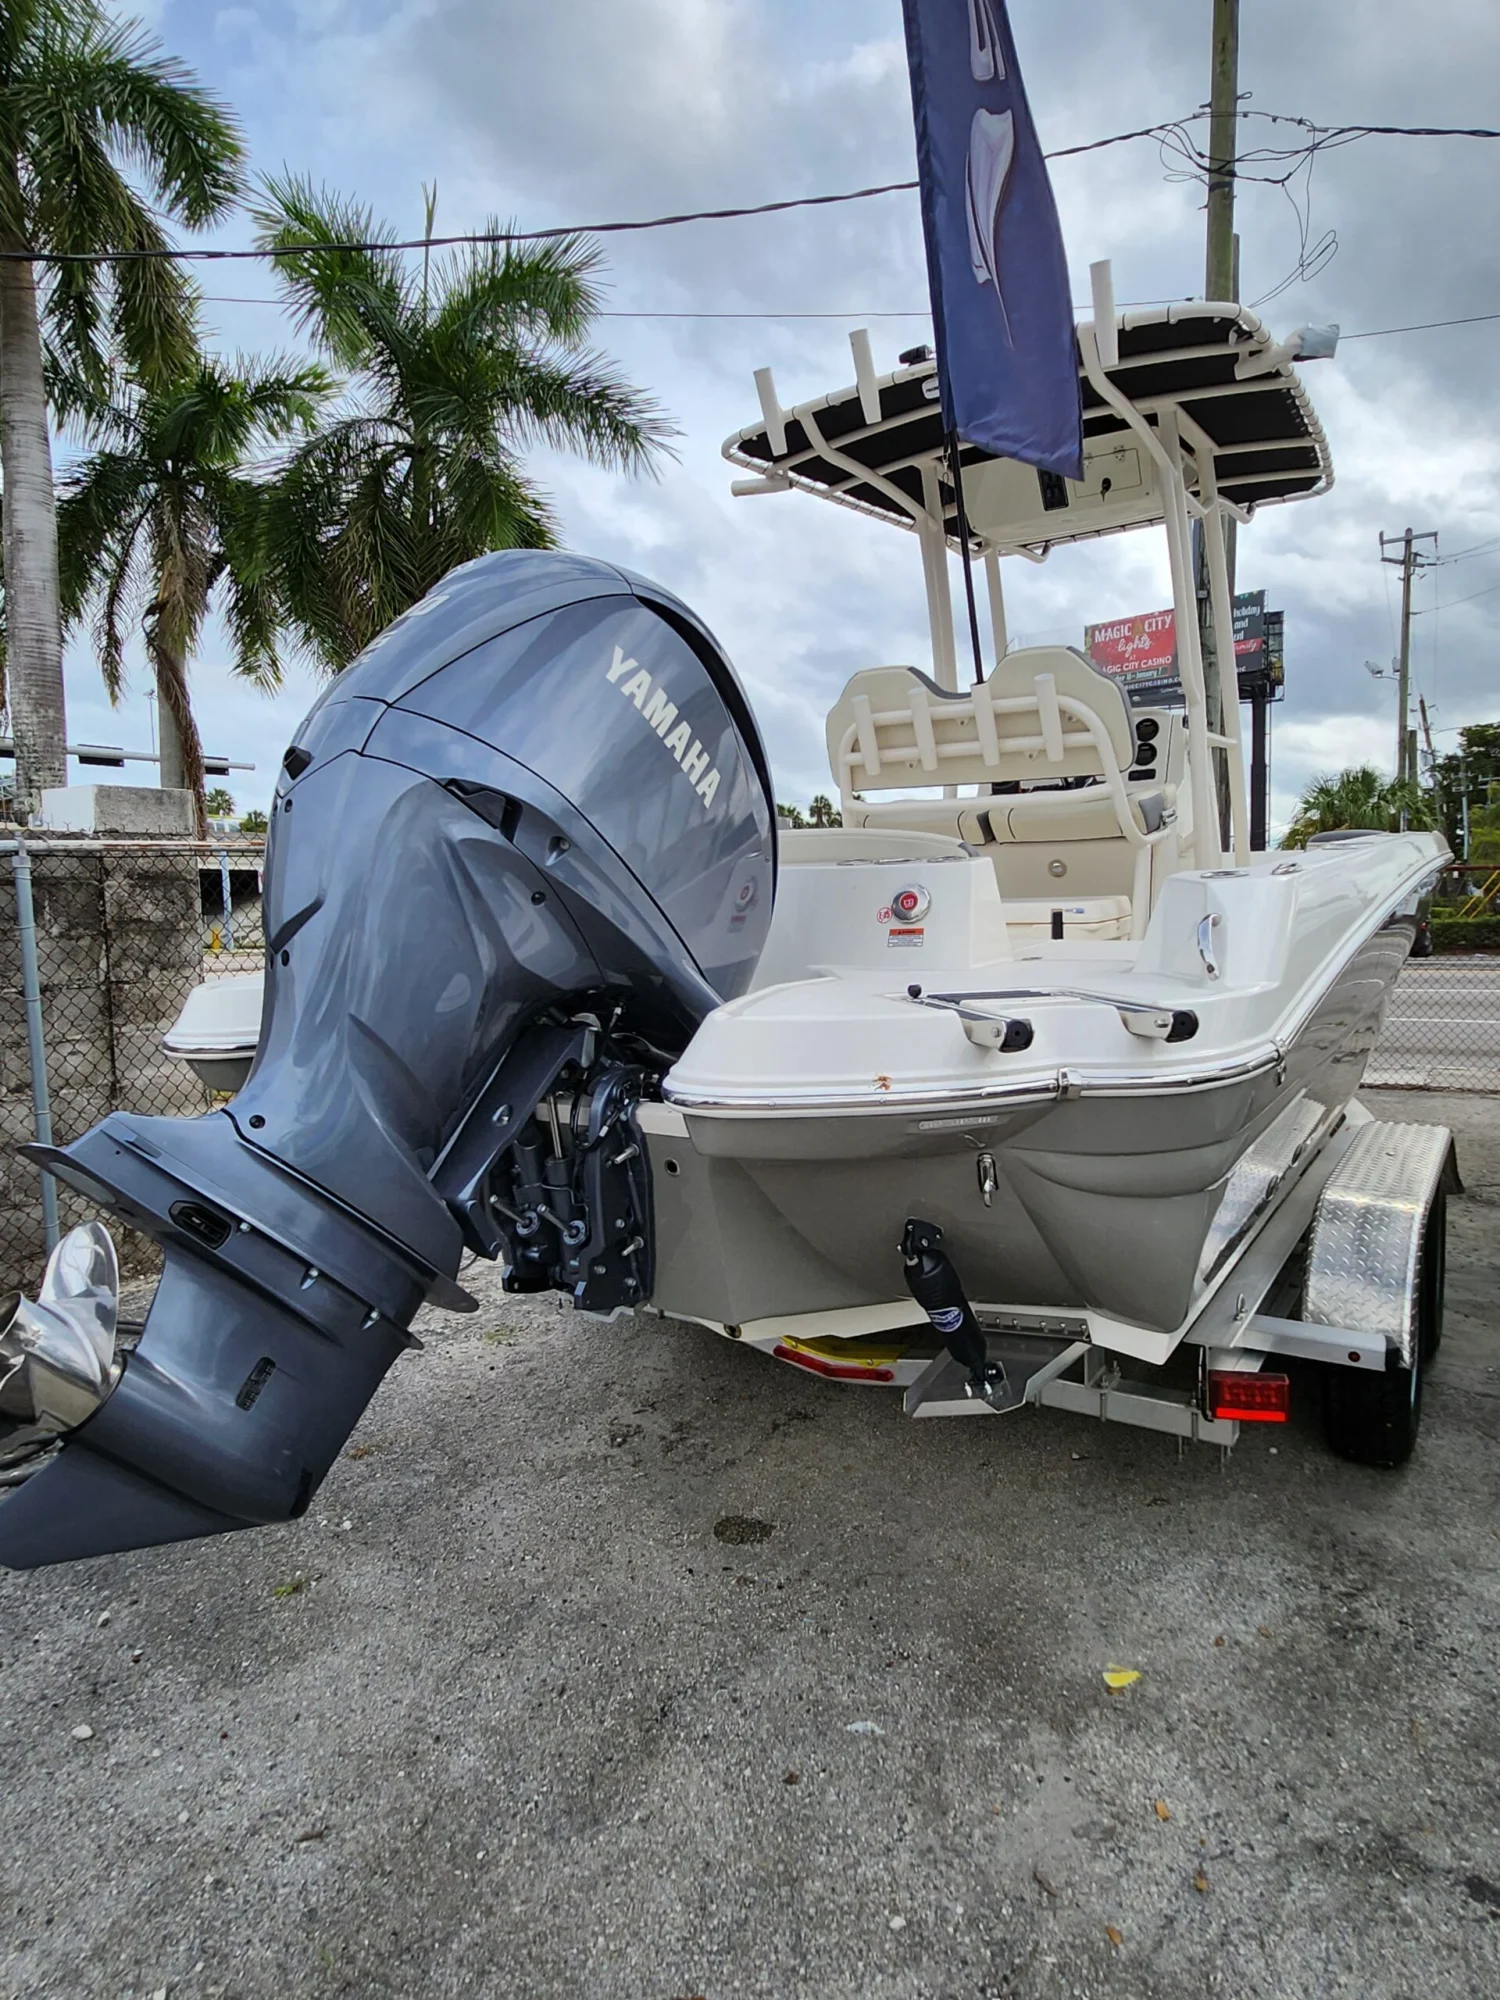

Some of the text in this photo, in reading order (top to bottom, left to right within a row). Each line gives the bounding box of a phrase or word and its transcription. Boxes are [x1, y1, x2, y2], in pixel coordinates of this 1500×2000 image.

[1095, 614, 1172, 643] MAGIC CITY
[1117, 633, 1151, 658] lights
[1103, 655, 1172, 674] AGIC CITY CASINO
[605, 644, 721, 809] YAMAHA
